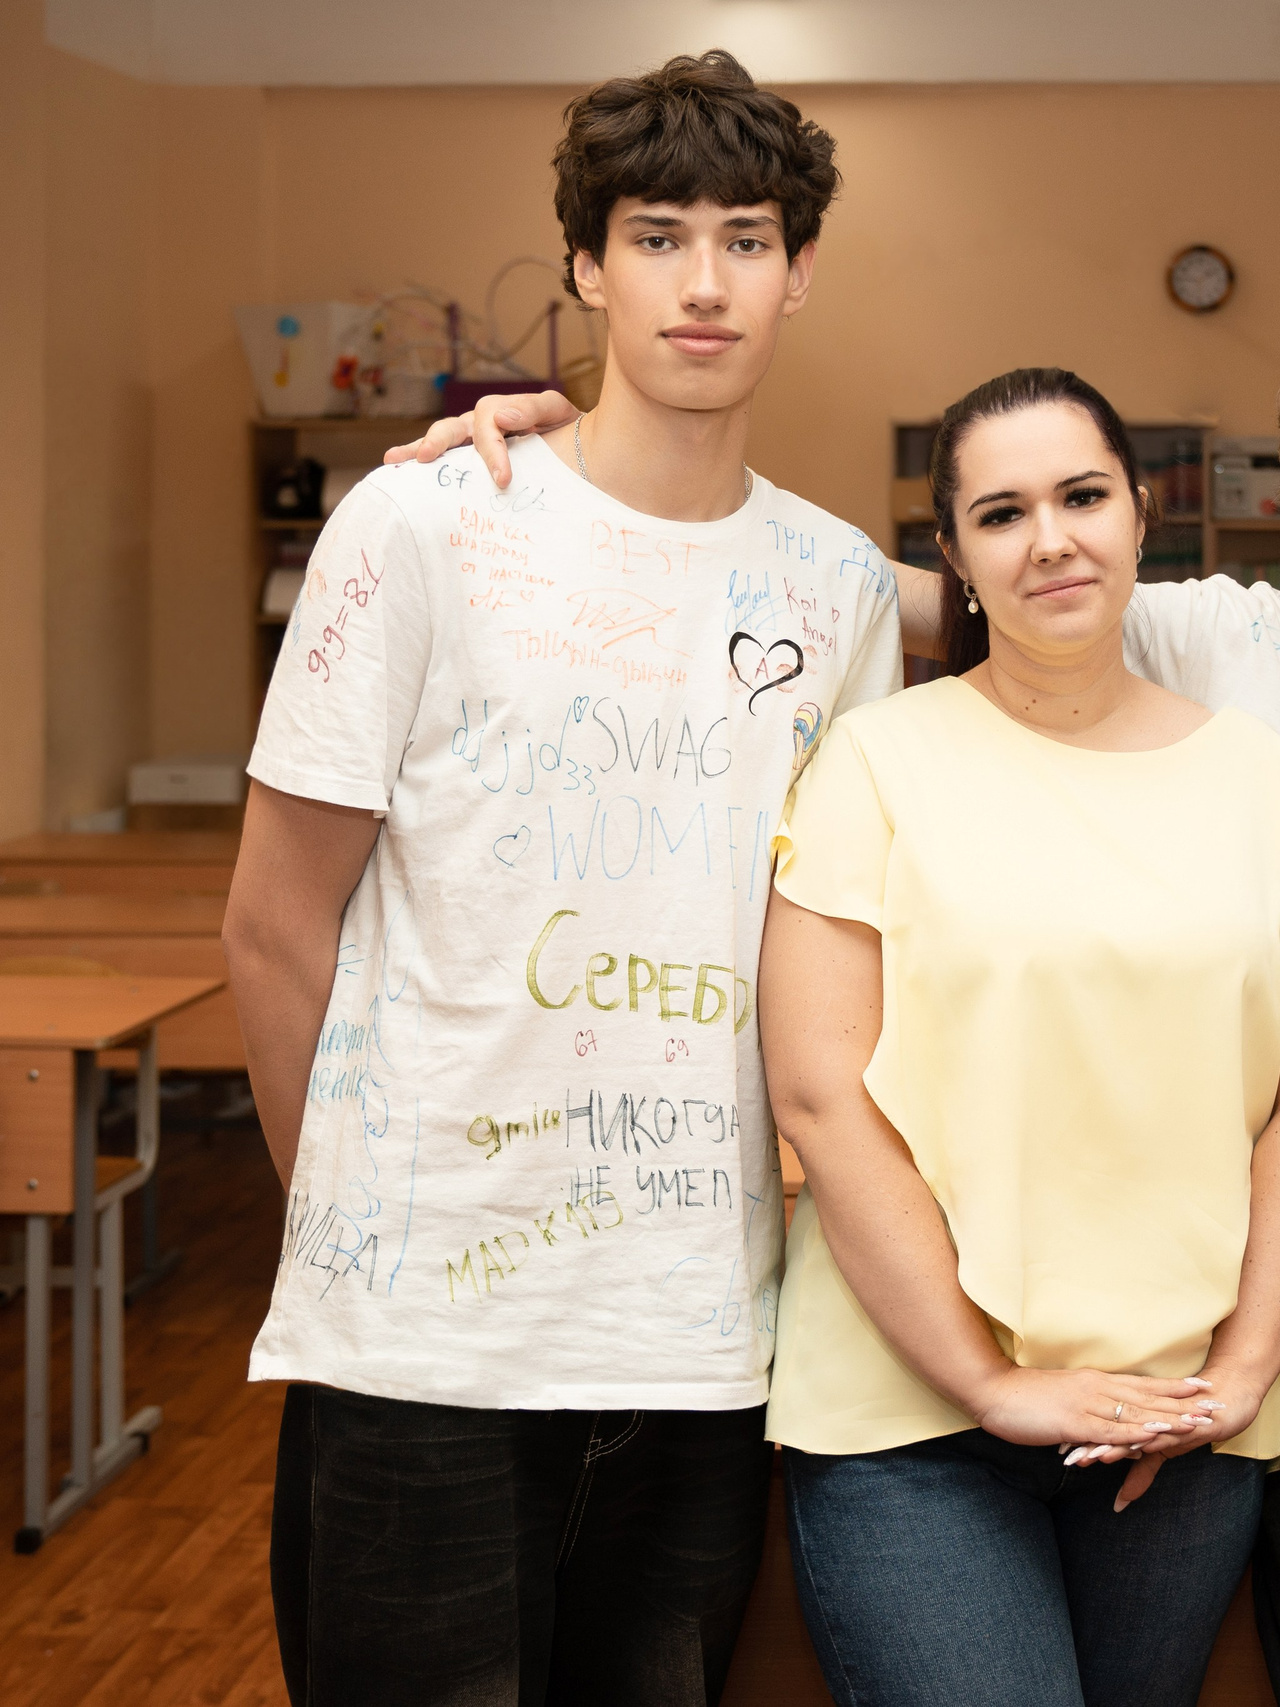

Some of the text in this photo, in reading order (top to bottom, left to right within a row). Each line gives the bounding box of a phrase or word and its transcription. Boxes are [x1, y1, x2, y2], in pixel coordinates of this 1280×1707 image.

[437, 464, 472, 489] 67
[589, 518, 718, 577] BEST
[592, 696, 733, 788] SWAG
[574, 1028, 599, 1057] 67
